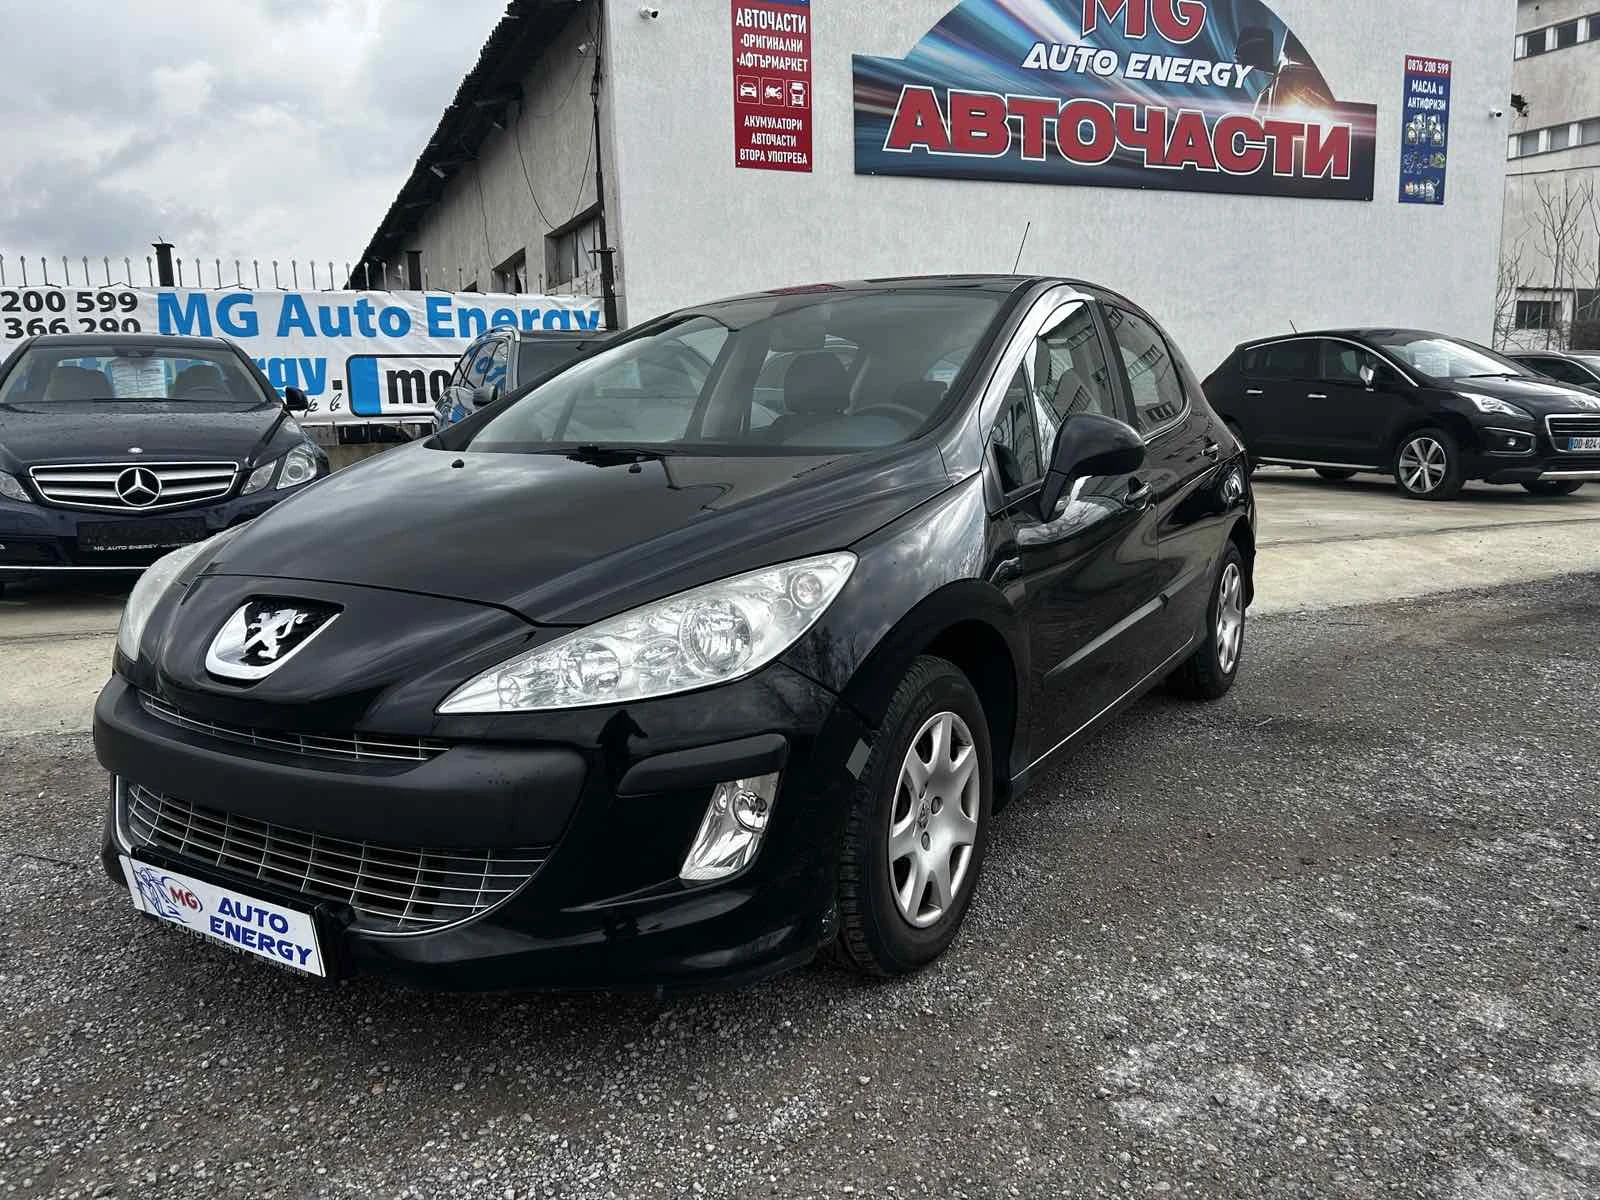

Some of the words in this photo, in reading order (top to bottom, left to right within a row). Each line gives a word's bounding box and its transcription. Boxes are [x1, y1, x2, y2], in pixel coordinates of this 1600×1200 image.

[736, 8, 807, 33] АВТОЧАСТИ
[1022, 42, 1119, 76] AUTO
[1123, 52, 1254, 89] ENERGY
[1411, 79, 1437, 94] МАСЛА
[744, 115, 803, 131] АКУМУЛАТОРИ
[882, 84, 1352, 180] АВТОЧАСТИ
[751, 132, 797, 147] АВТОЧАСТИ
[739, 148, 766, 163] ВТОРА
[767, 150, 808, 165] УПОТРЕБА
[0, 290, 66, 312] 200
[76, 291, 138, 312] 599
[158, 292, 259, 337] MG
[276, 294, 411, 338] Auto
[425, 296, 601, 338] Energy
[4, 317, 70, 339] 366
[169, 887, 199, 910] MG
[218, 896, 289, 934] AUTO
[209, 915, 313, 965] ENERGY
